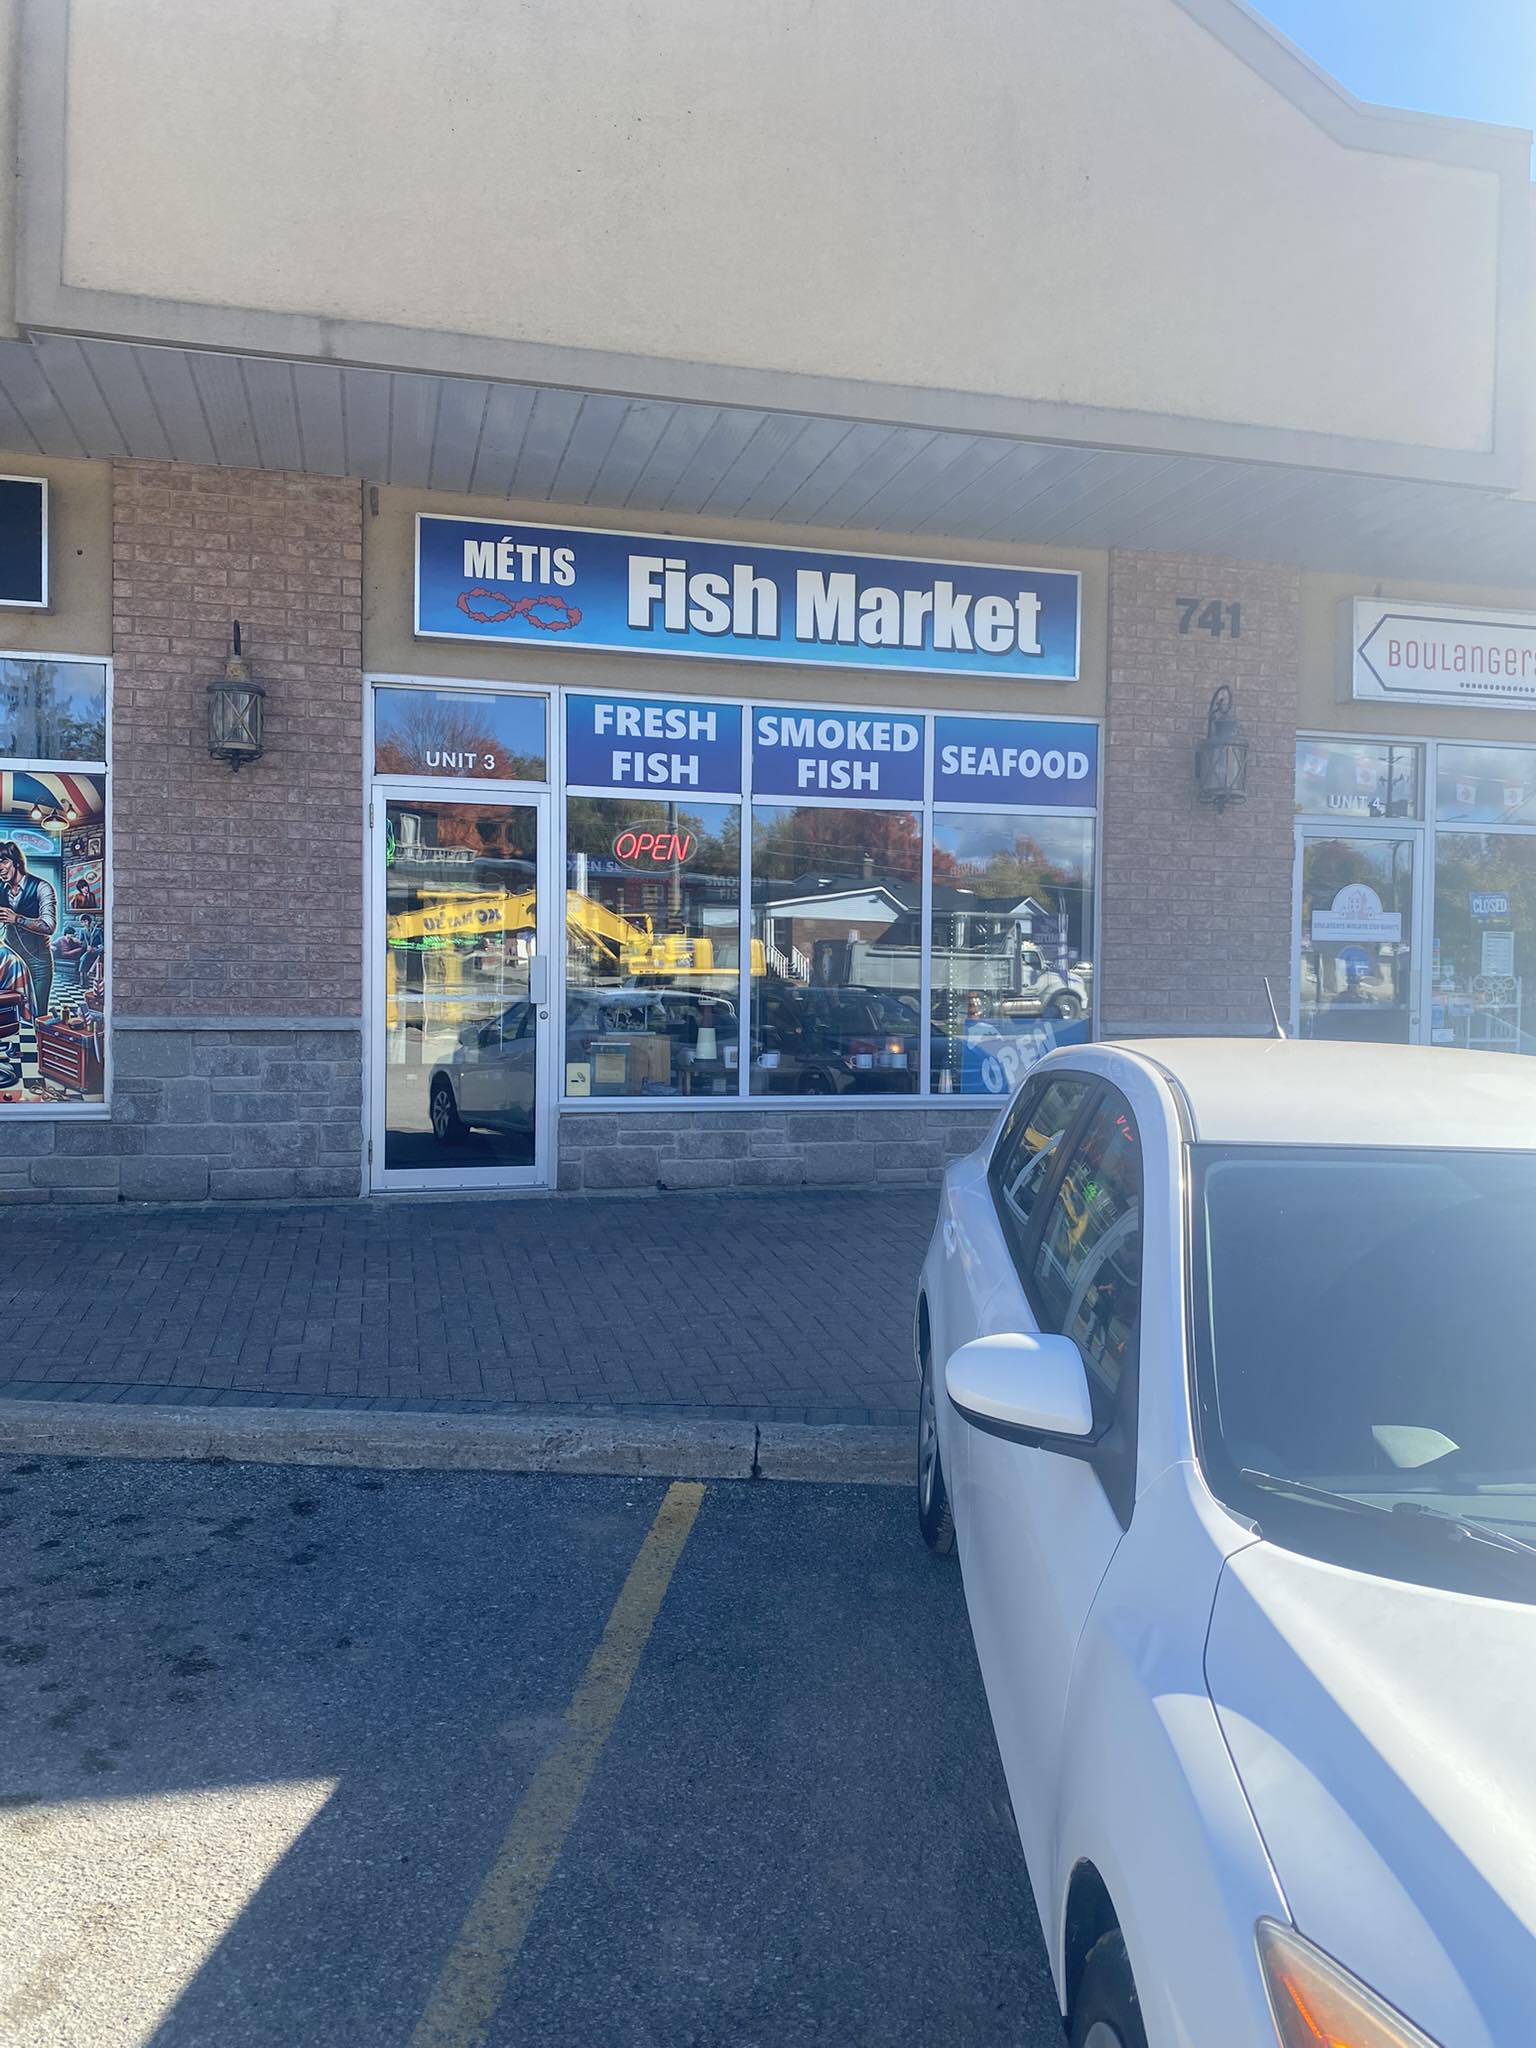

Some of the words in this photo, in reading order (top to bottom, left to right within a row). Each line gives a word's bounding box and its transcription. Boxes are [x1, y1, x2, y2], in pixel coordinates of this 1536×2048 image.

[463, 536, 576, 587] MÉTIS
[627, 554, 778, 637] Fish
[796, 568, 1042, 655] Market
[1175, 598, 1241, 638] 741
[594, 703, 717, 741] FRESH
[757, 716, 919, 752] SMOKED
[426, 750, 477, 770] UNIT
[483, 754, 496, 770] 3
[612, 750, 699, 785] FISH
[797, 758, 879, 791] FISH
[941, 745, 1089, 780] SEAFOOD
[1329, 794, 1368, 809] UNIT
[616, 832, 690, 861] OPEN
[1472, 898, 1507, 913] CLOSED
